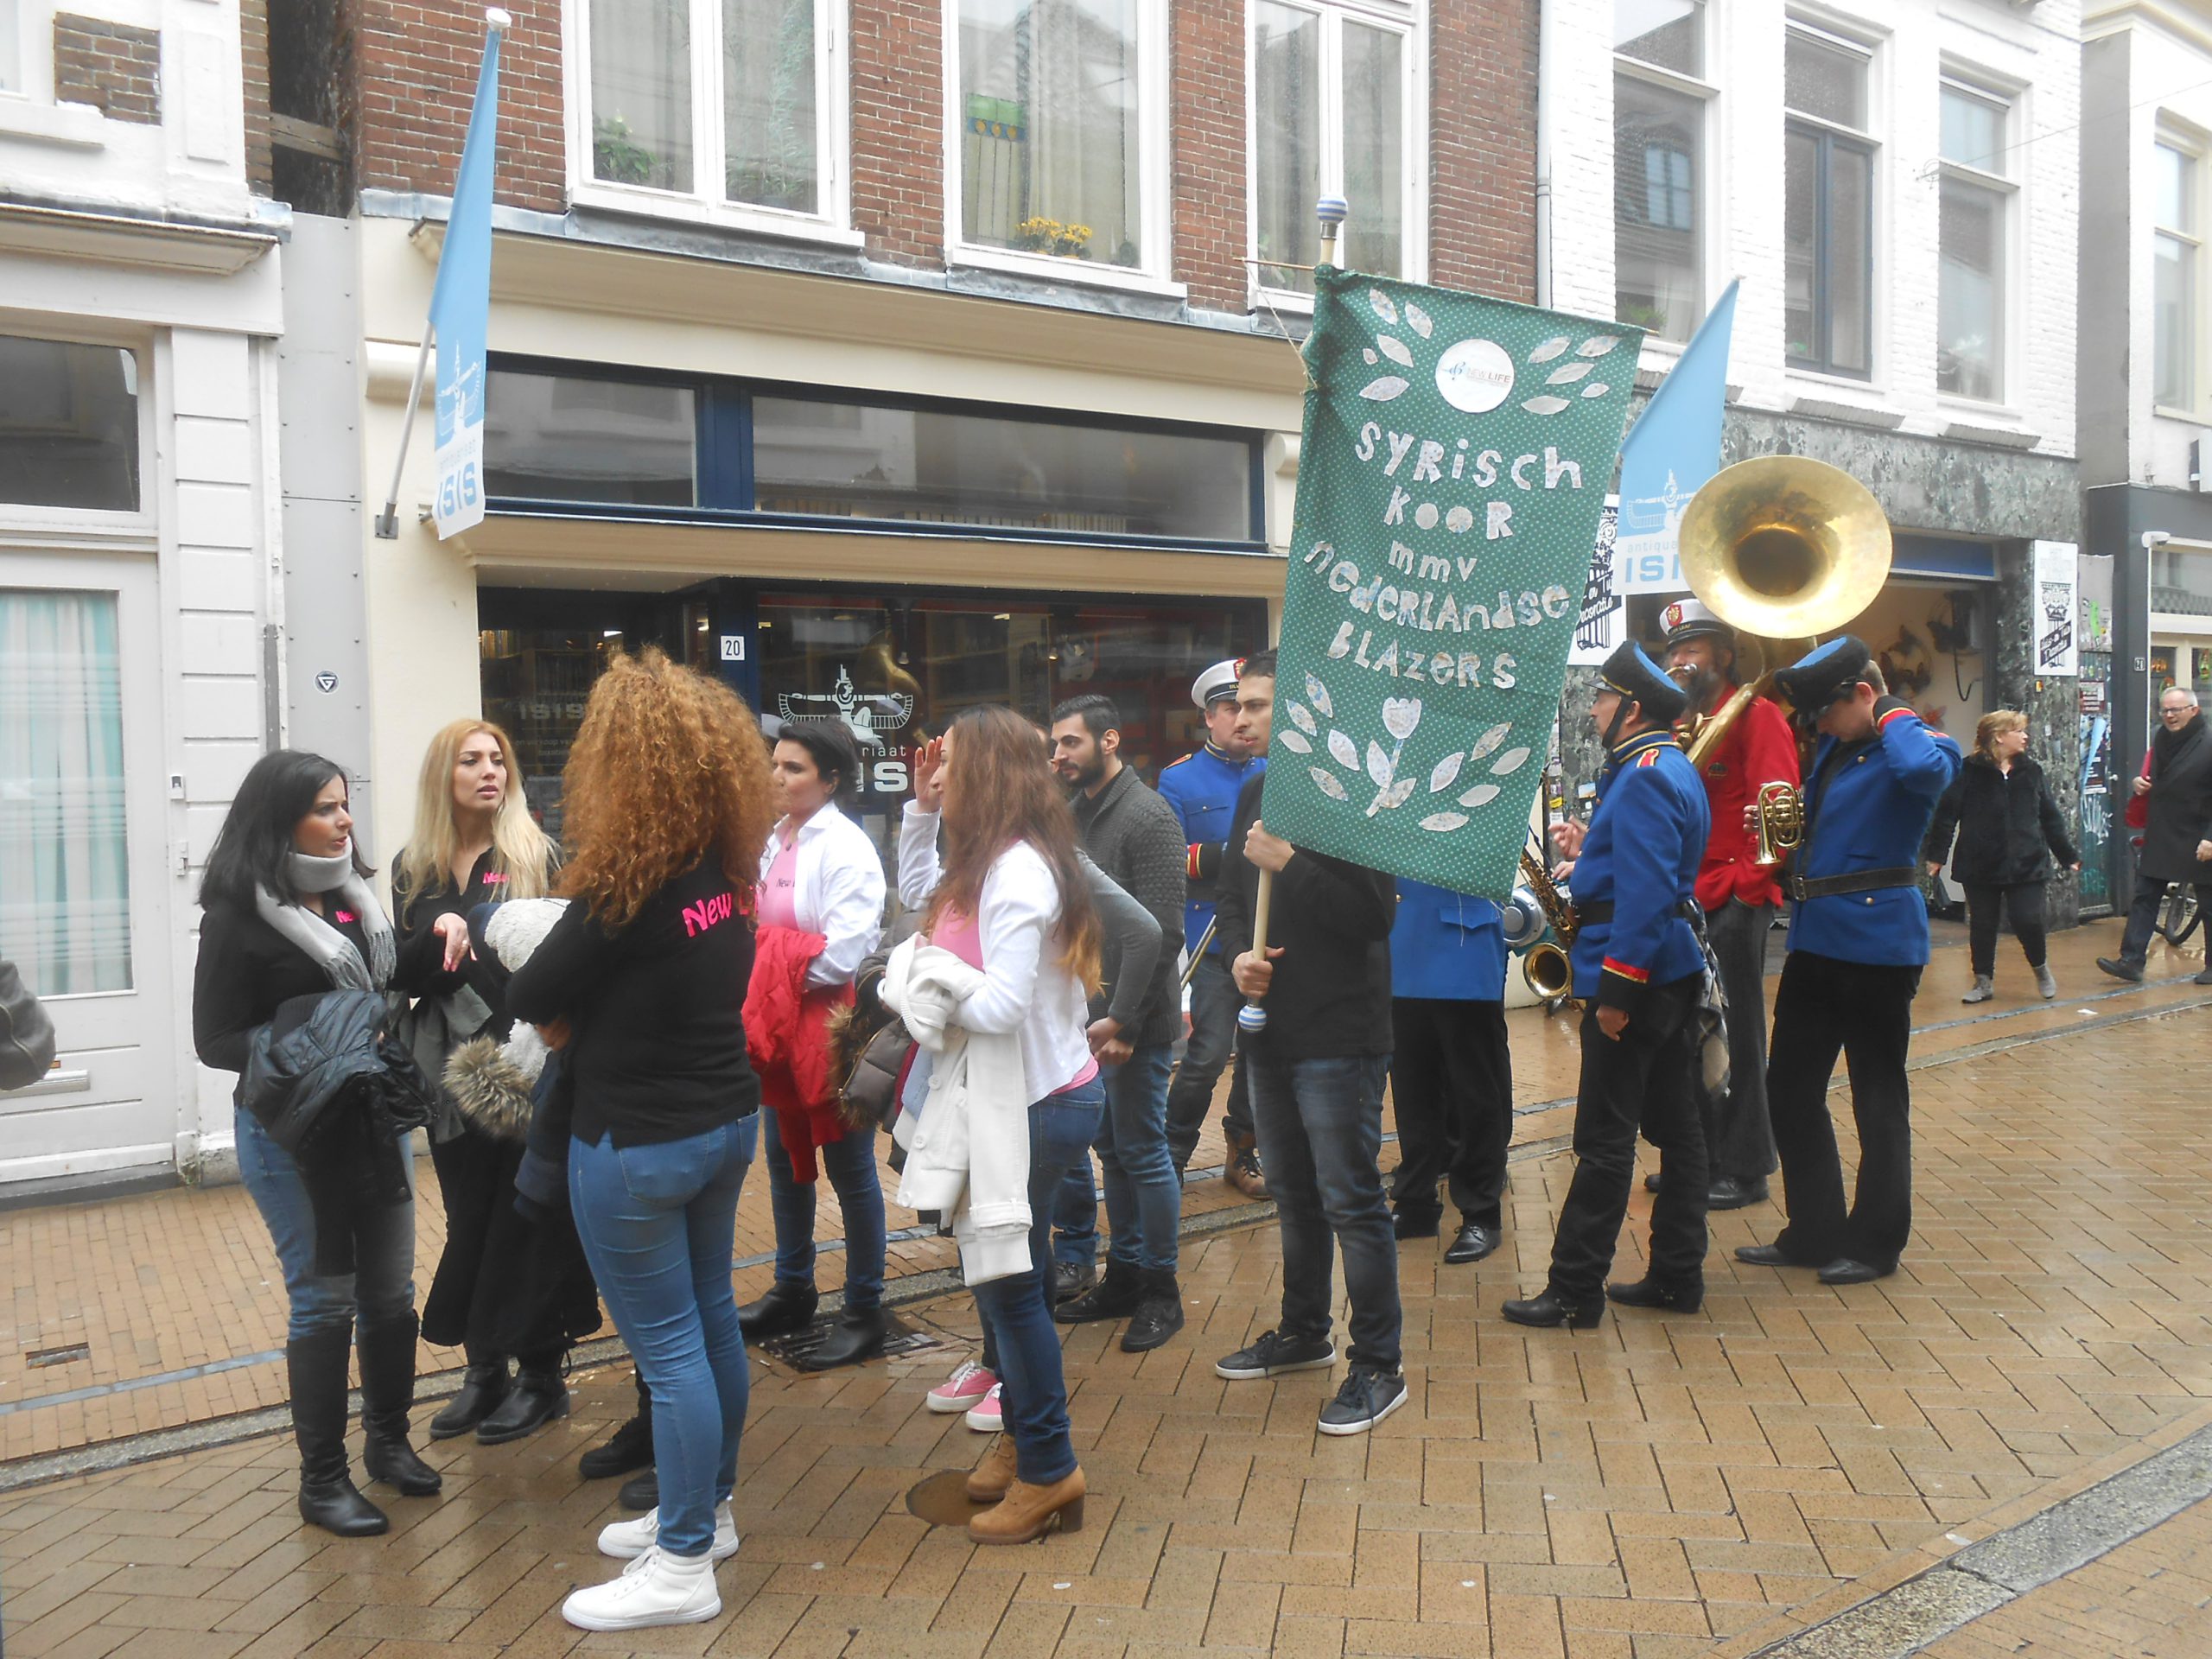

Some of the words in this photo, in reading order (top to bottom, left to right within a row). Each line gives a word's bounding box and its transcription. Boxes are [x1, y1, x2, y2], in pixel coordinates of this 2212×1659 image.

[1488, 372, 1512, 385] LIFE
[437, 461, 477, 521] ISIS
[1388, 539, 1478, 582] mmv
[725, 639, 741, 657] 20
[519, 702, 586, 720] ISIS
[861, 744, 906, 758] riaat
[855, 760, 908, 792] IS
[682, 892, 733, 938] New
